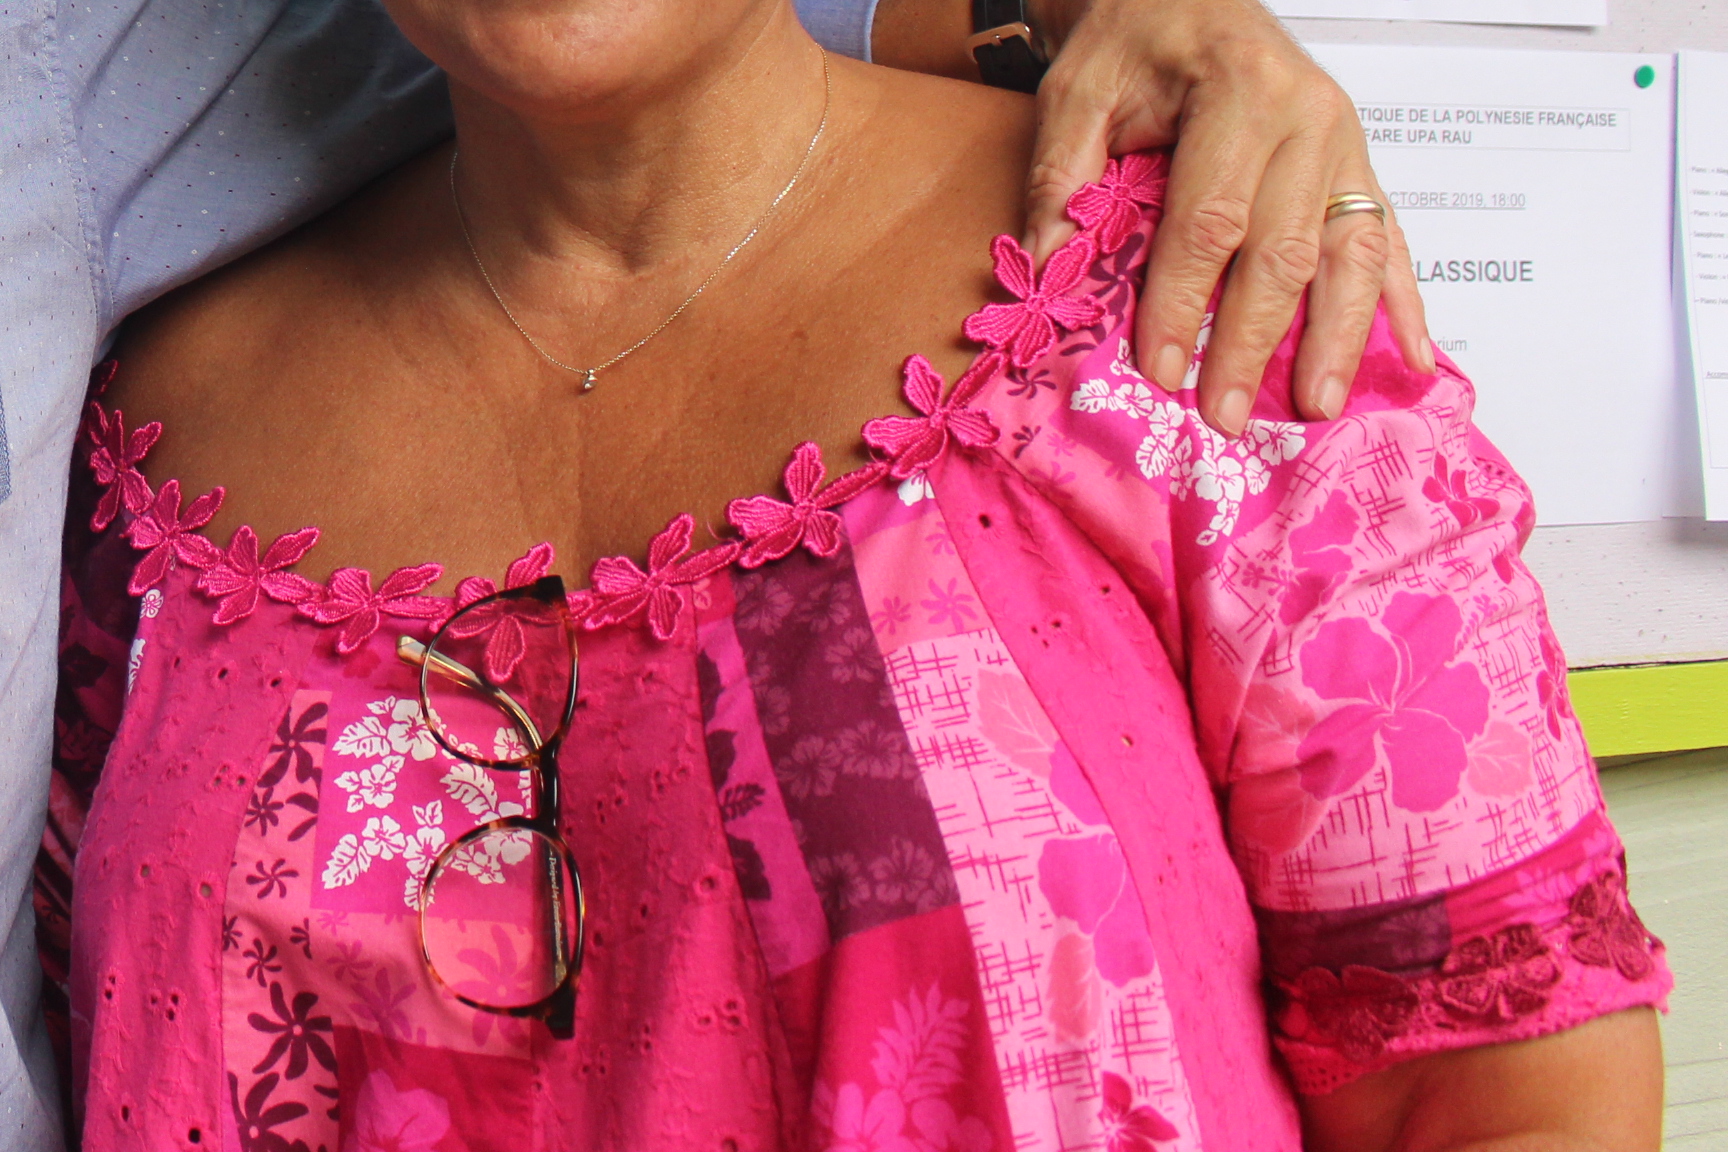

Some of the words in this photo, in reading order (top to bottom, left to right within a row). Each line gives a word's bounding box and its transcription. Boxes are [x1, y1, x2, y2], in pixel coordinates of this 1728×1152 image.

[1408, 108, 1429, 123] DE
[1433, 109, 1452, 123] LA
[1456, 110, 1535, 126] POLYNESIE
[1538, 111, 1618, 129] FRANÇAISE
[1407, 129, 1439, 144] UPA
[1441, 129, 1473, 145] RAU
[1384, 191, 1449, 207] CTOBRE
[1491, 193, 1526, 208] 18:00
[1412, 259, 1534, 284] LASSIQUE
